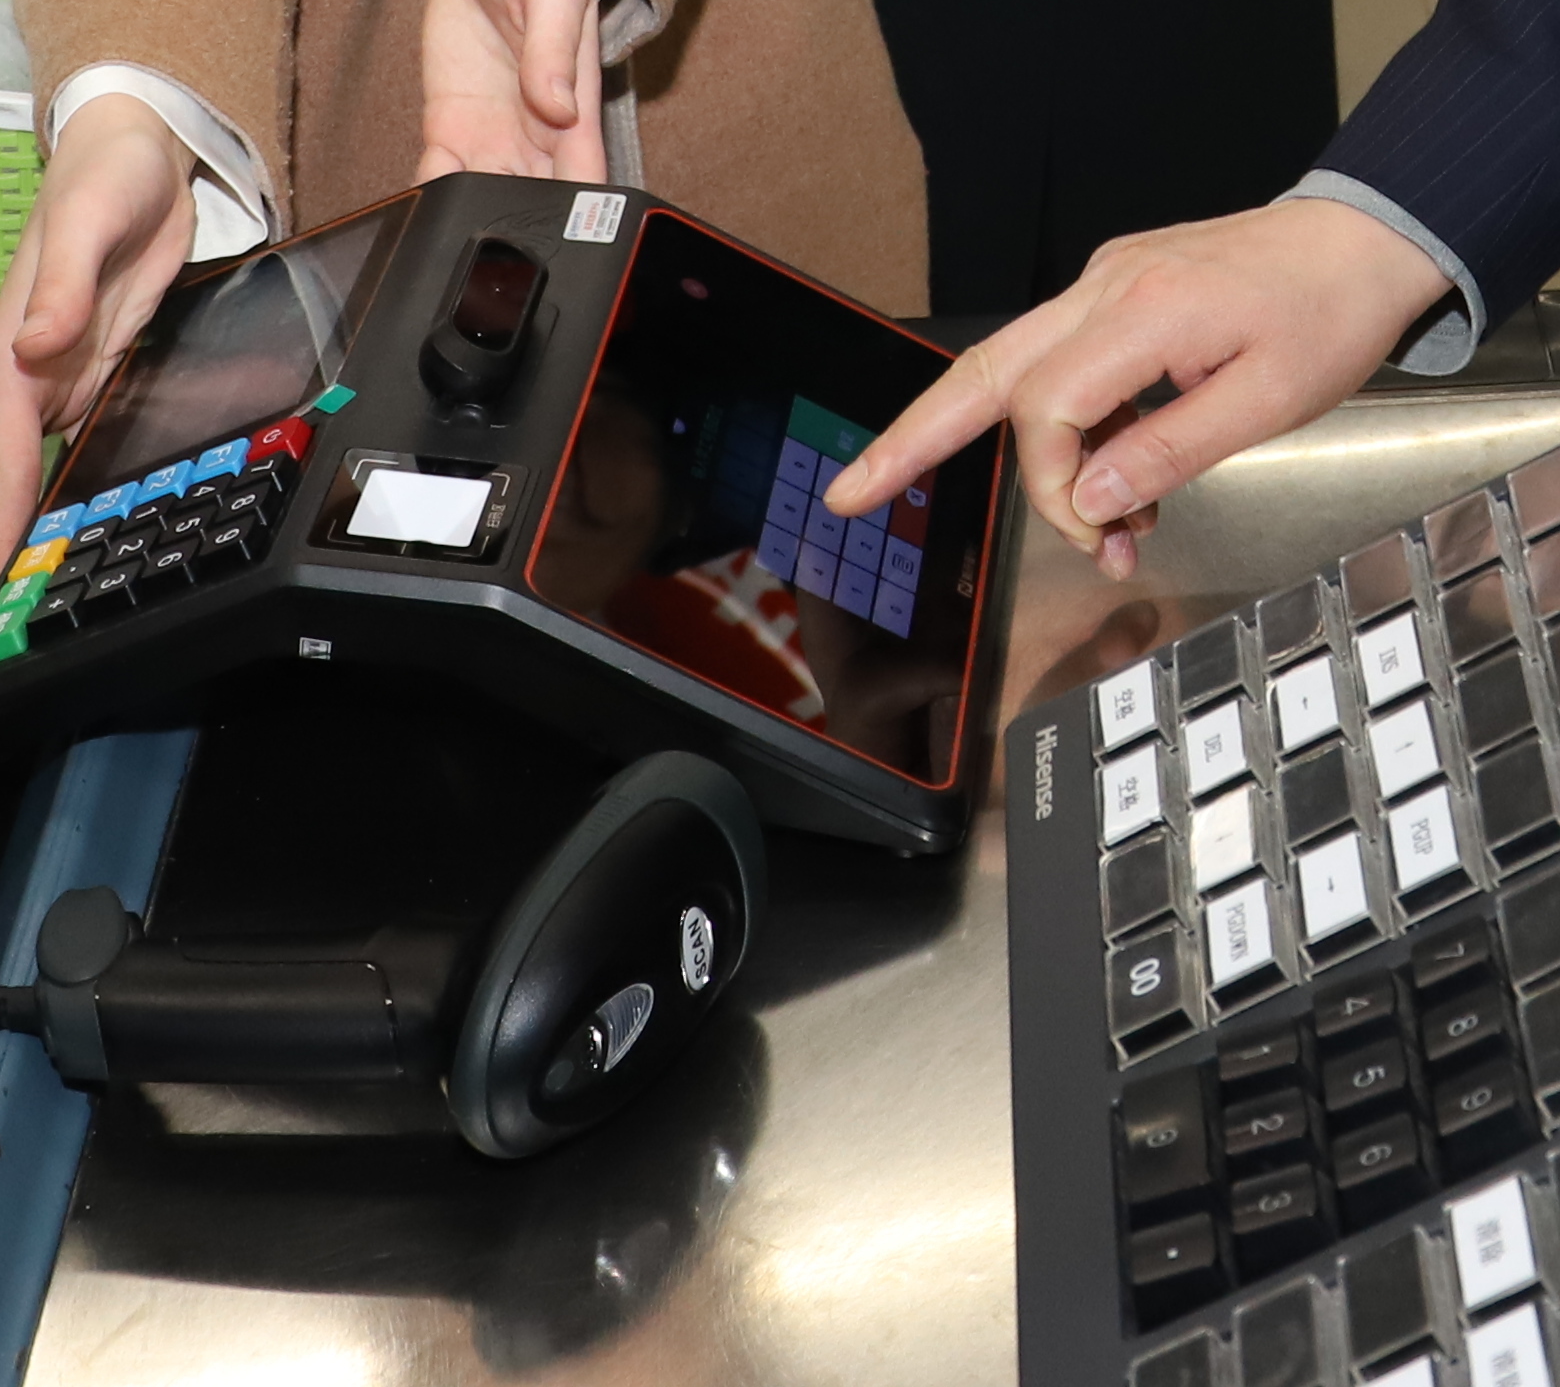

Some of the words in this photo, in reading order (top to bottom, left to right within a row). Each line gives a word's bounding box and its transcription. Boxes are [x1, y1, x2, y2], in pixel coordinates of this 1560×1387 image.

[205, 444, 234, 467] F1
[251, 459, 274, 473] 7
[148, 466, 176, 492] F2
[94, 488, 123, 511] F3
[192, 484, 217, 499] 4
[230, 493, 257, 510] 8
[41, 509, 70, 534] F4
[134, 505, 158, 520] 1
[79, 526, 107, 542] 0
[174, 517, 201, 534] 5
[214, 528, 241, 545] 9
[117, 537, 145, 556] 2
[156, 551, 184, 568] 6
[99, 573, 127, 590] 3
[1378, 646, 1398, 674] INS
[1202, 735, 1222, 761] DEL
[1033, 724, 1059, 821] Hisense
[1410, 817, 1433, 855] PGUP
[687, 916, 710, 980] SCAN
[1129, 957, 1161, 996] 00
[1344, 998, 1372, 1015] 4
[1448, 1014, 1479, 1039] 8
[1354, 1064, 1385, 1088] 5
[1462, 1086, 1493, 1112] 9
[1250, 1111, 1287, 1137] 2
[1360, 1143, 1393, 1167] 6
[1259, 1190, 1291, 1215] 3
